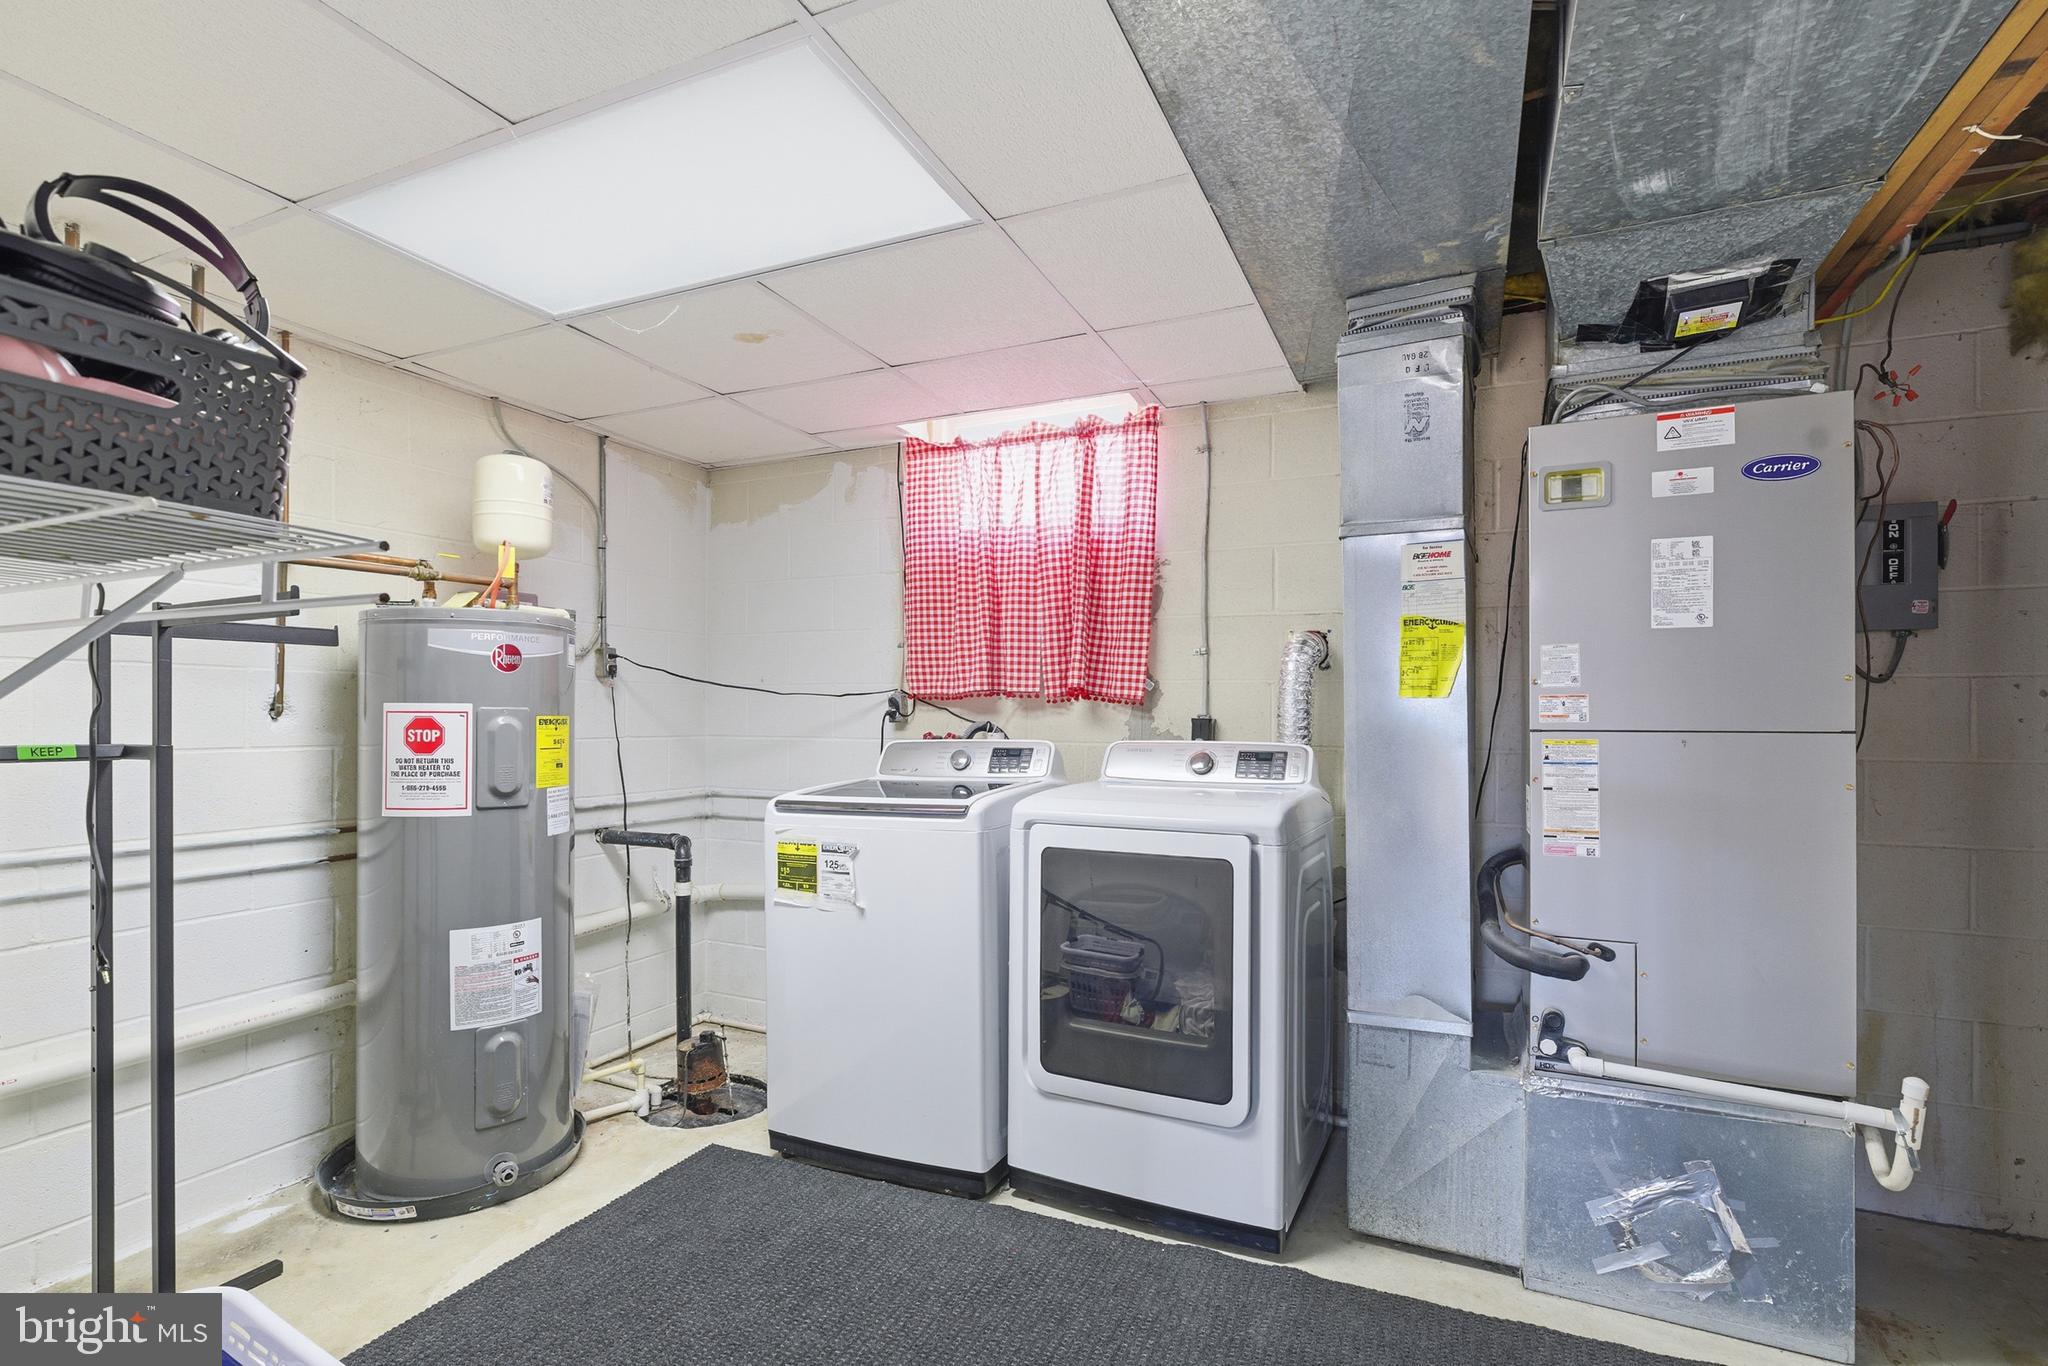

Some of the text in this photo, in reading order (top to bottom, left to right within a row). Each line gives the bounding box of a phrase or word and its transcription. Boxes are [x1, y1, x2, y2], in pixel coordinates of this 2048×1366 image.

[1752, 460, 1810, 474] Carrier
[1888, 523, 1899, 538] ON
[1888, 558, 1899, 580] OFF
[471, 632, 540, 644] PERFORMANCE
[407, 728, 440, 742] STOP
[30, 746, 63, 757] KEEP
[428, 770, 461, 778] PURCHASE
[824, 859, 839, 870] 125
